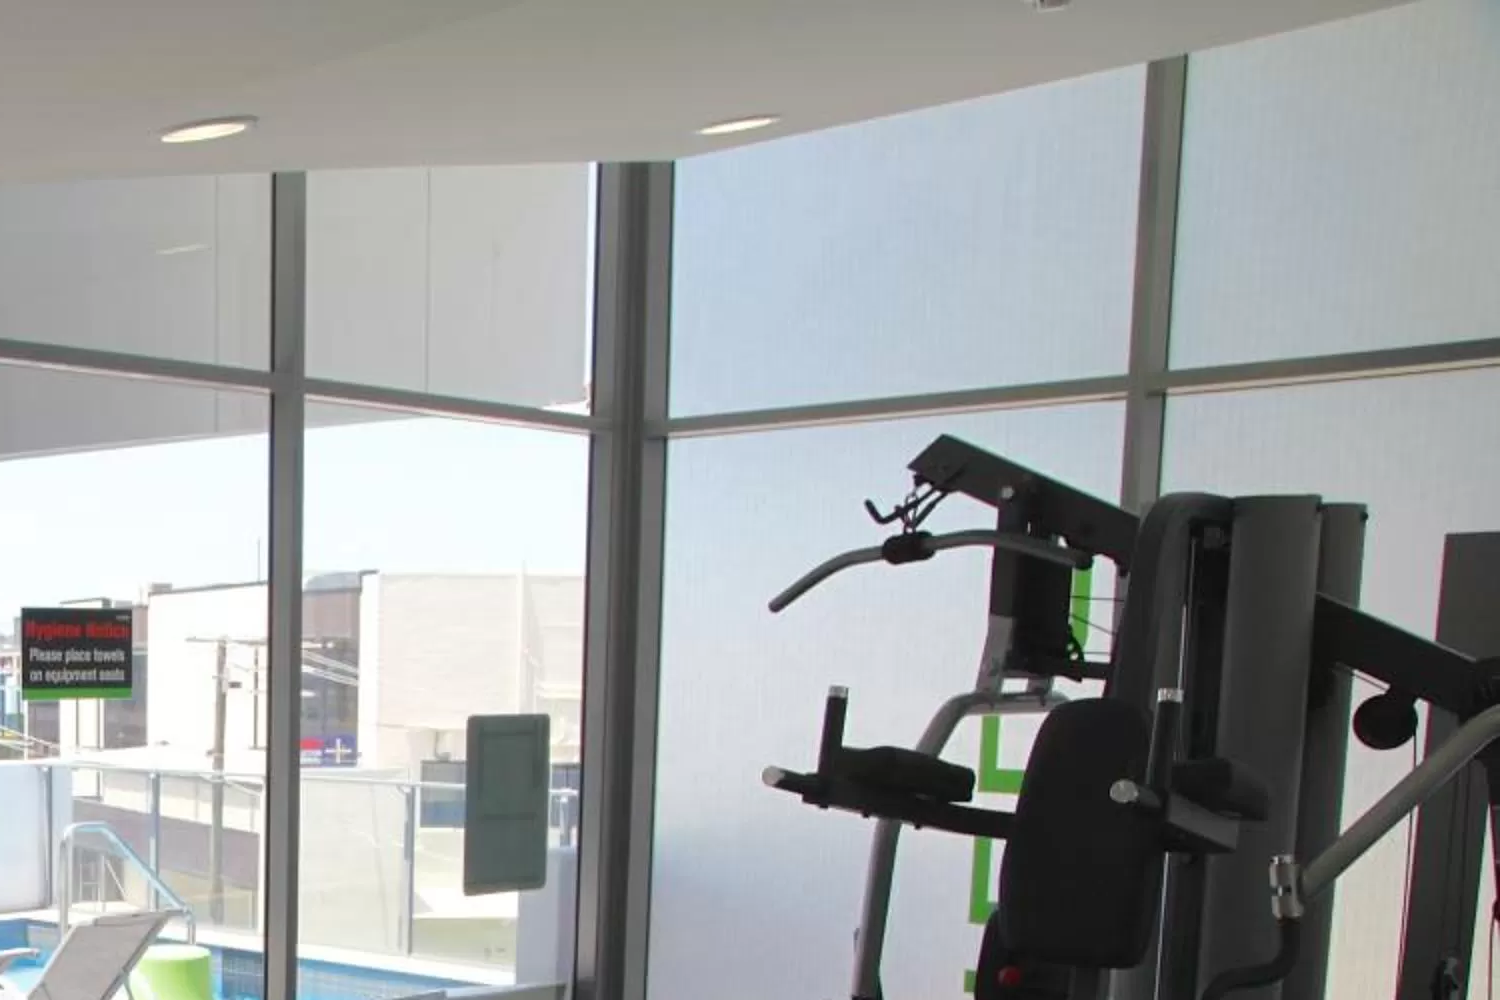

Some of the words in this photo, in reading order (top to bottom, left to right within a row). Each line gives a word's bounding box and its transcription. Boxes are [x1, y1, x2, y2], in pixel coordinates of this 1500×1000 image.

[25, 620, 82, 640] Hygiene
[29, 647, 63, 662] Please
[65, 647, 91, 664] place
[94, 648, 125, 662] towels
[29, 670, 42, 682] on
[45, 667, 97, 684] equipment
